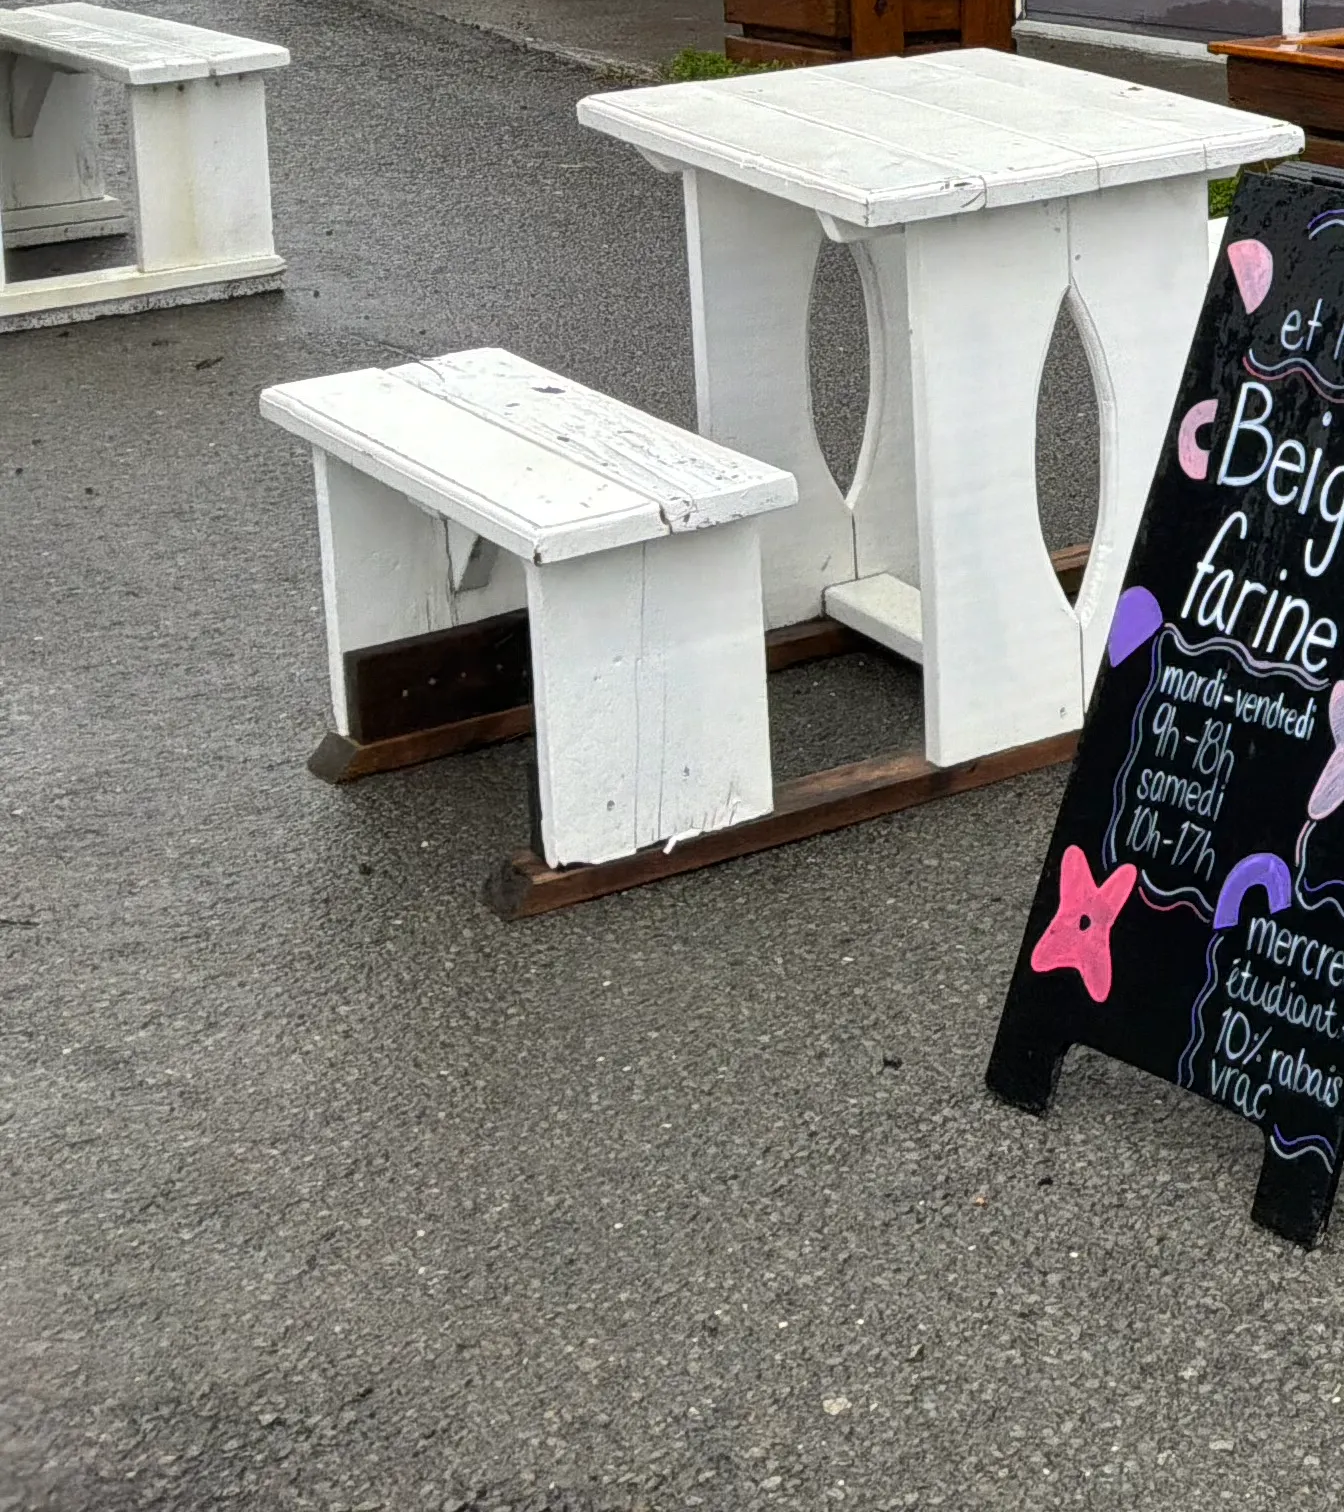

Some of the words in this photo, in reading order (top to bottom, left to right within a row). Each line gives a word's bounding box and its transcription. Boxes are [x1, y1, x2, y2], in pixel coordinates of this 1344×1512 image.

[1280, 298, 1324, 352] et
[1180, 510, 1339, 673] farine
[1159, 665, 1318, 741] mardi-vendredi
[1136, 768, 1226, 822] samedi
[1211, 1058, 1273, 1120] vrac
[1214, 1006, 1273, 1066] 10%
[1267, 1047, 1344, 1108] rabais
